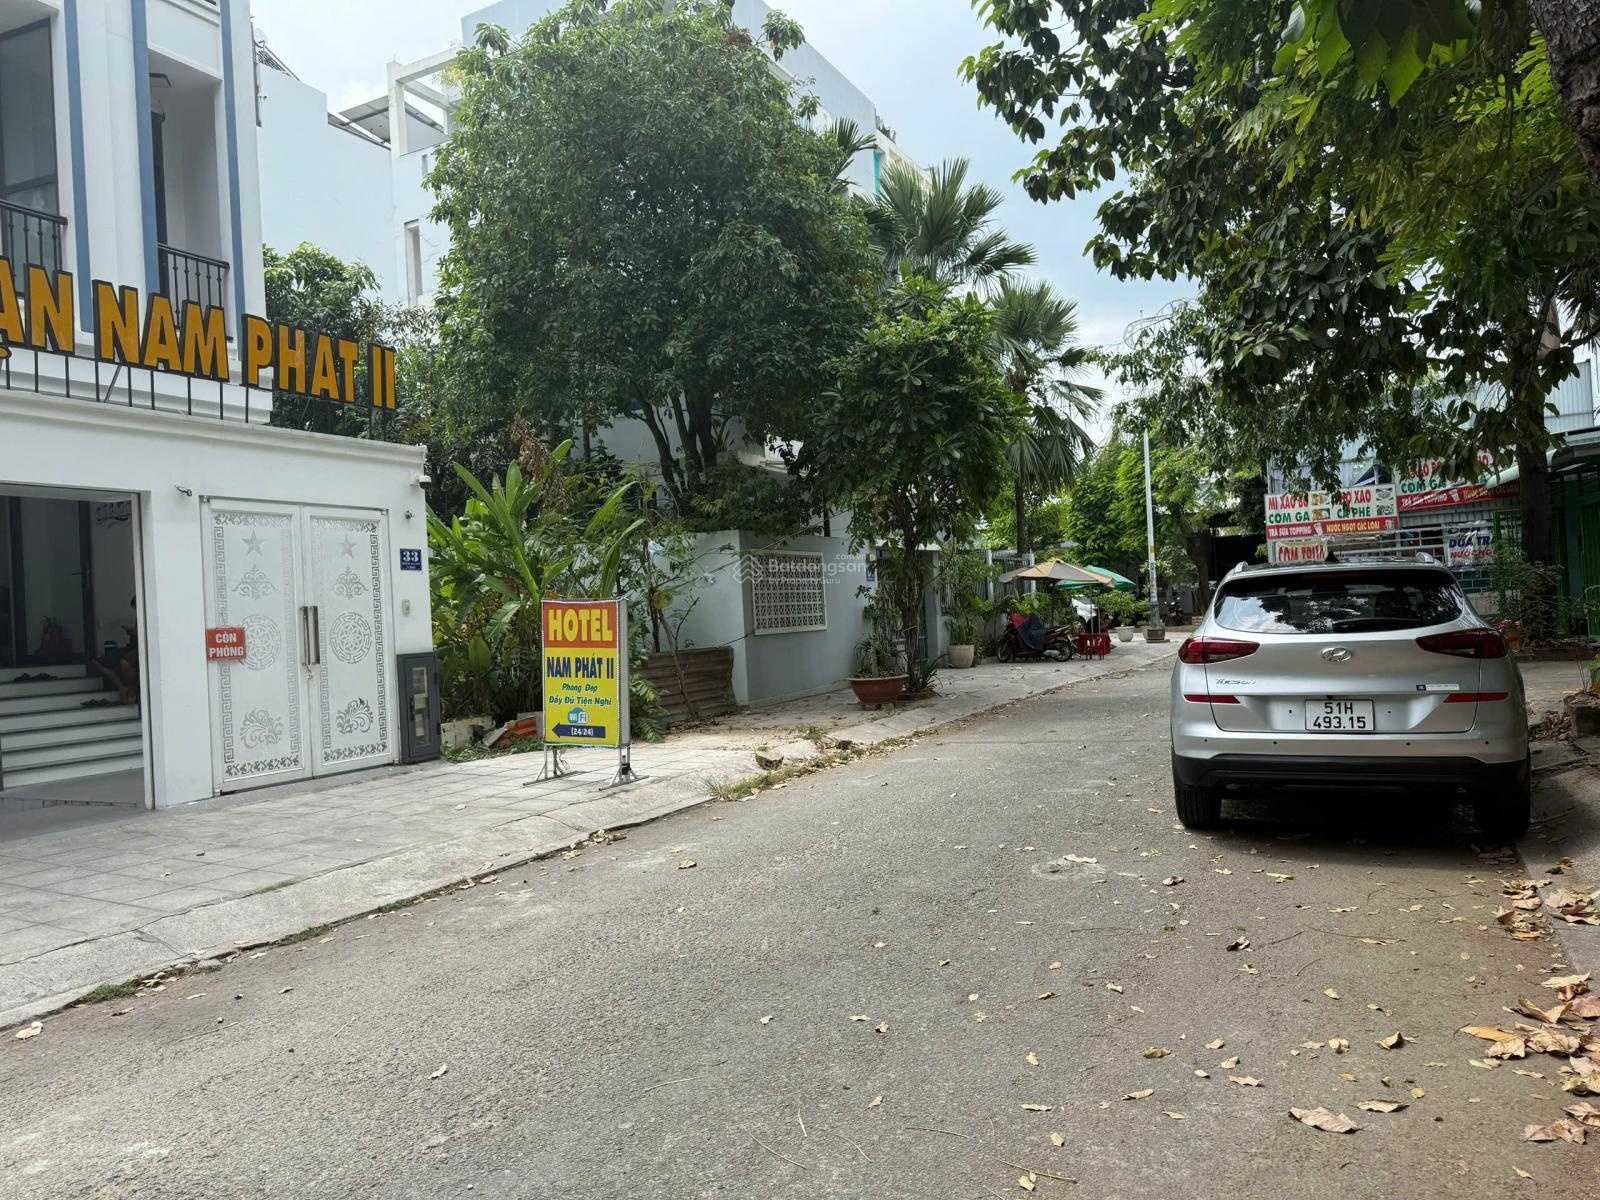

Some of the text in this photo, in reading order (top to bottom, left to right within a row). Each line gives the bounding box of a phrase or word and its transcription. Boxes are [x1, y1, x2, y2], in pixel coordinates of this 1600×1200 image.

[93, 279, 229, 383] NAM
[367, 342, 397, 410] II
[1289, 526, 1312, 535] TOPPING
[403, 551, 419, 562] 33
[548, 608, 614, 642] HOTEL
[215, 630, 237, 644] CÒN
[209, 644, 244, 658] PHÒNG
[547, 651, 614, 679] NAM PHÁT II
[576, 696, 593, 707] Tiện
[594, 697, 612, 707] Nghi
[1323, 702, 1354, 715] 51H
[1312, 716, 1367, 730] 493.15
[571, 727, 594, 736] (24/24)
